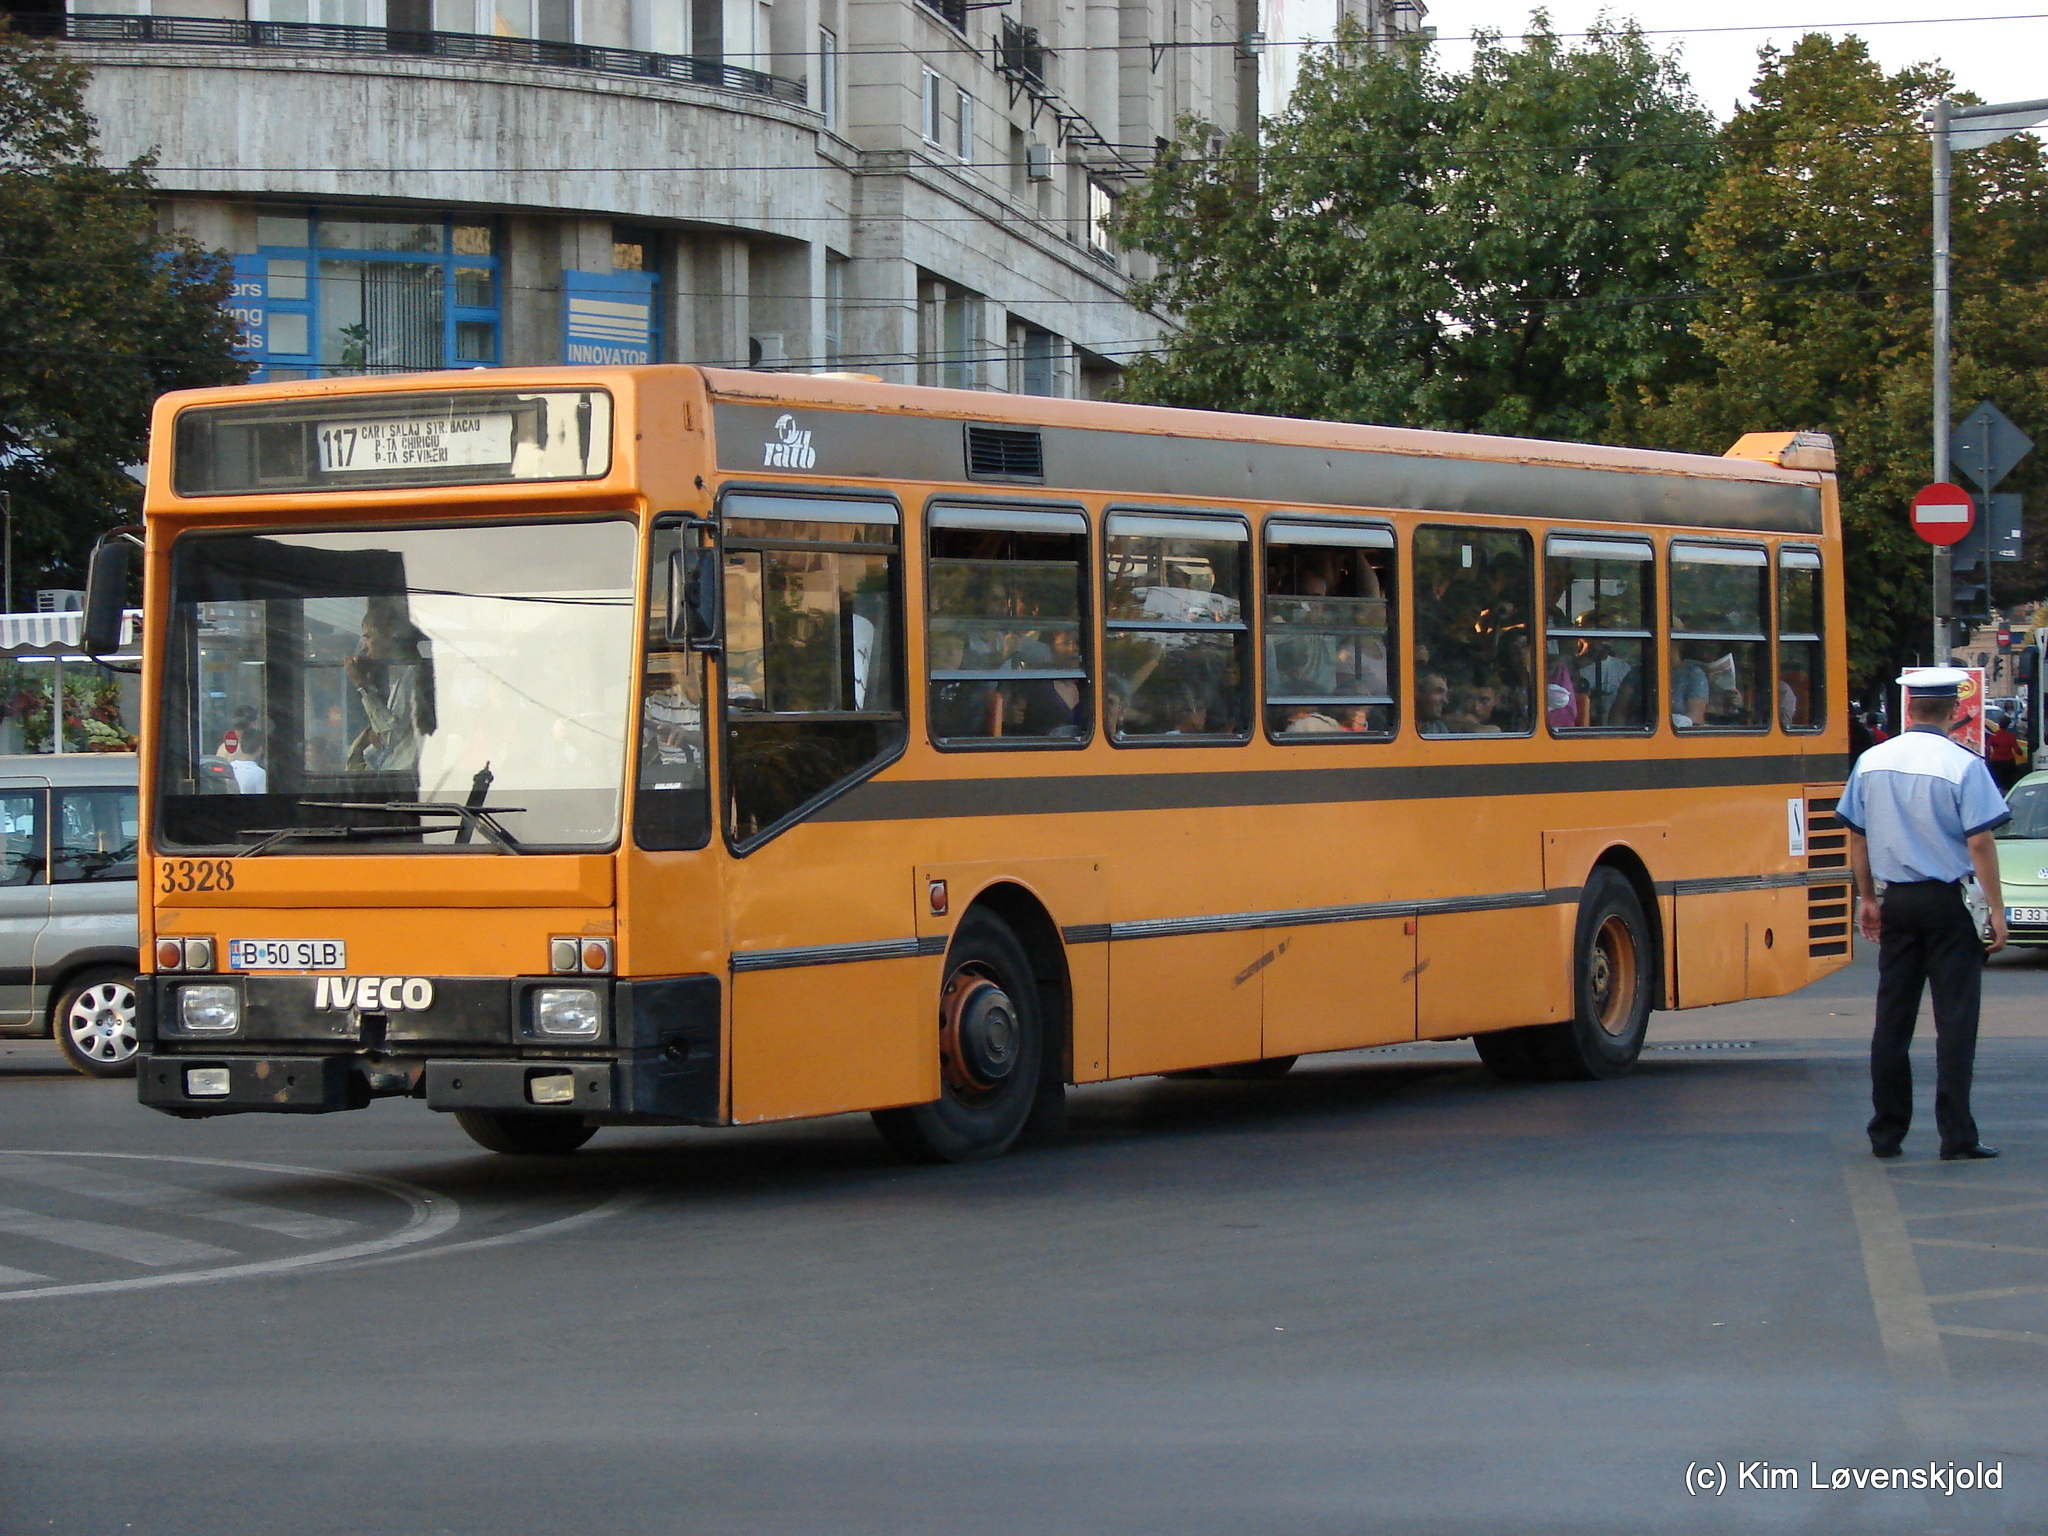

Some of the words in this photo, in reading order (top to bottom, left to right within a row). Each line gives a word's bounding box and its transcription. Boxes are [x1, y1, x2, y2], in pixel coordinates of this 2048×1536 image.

[568, 343, 648, 365] INNOVATOR
[389, 423, 420, 437] SALAJ
[450, 419, 480, 433] BACAU
[323, 428, 358, 468] 117
[375, 438, 398, 452] P-TA
[375, 452, 398, 463] P-TA
[161, 860, 234, 893] 3328
[2014, 909, 2022, 920] B
[2027, 909, 2041, 920] 33
[243, 943, 257, 964] B
[266, 943, 290, 965] 50
[297, 943, 337, 966] SLB
[315, 976, 434, 1011] IVECO
